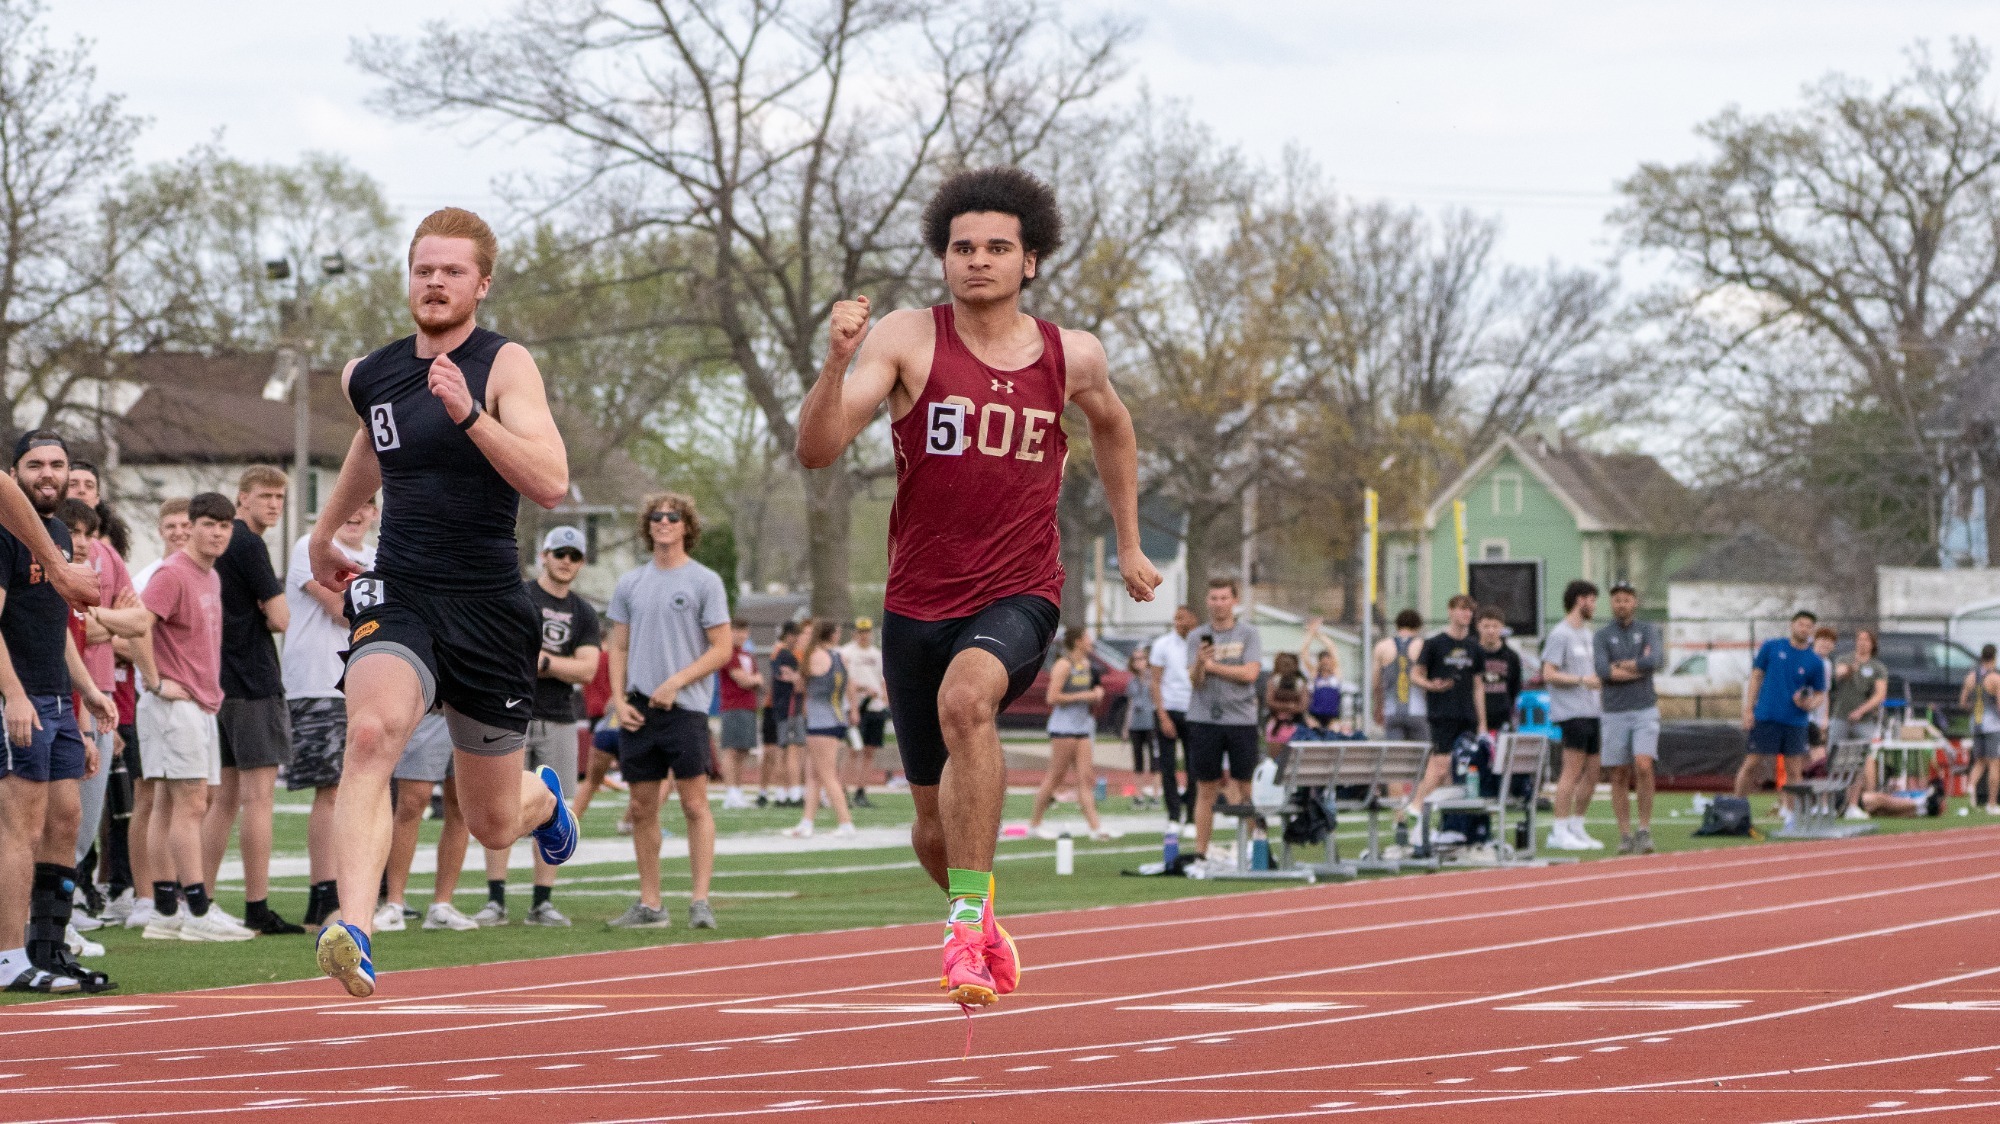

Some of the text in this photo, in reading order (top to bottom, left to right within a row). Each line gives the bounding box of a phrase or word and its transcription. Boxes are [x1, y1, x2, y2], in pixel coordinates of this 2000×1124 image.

[374, 407, 393, 448] 3
[930, 406, 957, 451] 5
[354, 579, 377, 612] 3
